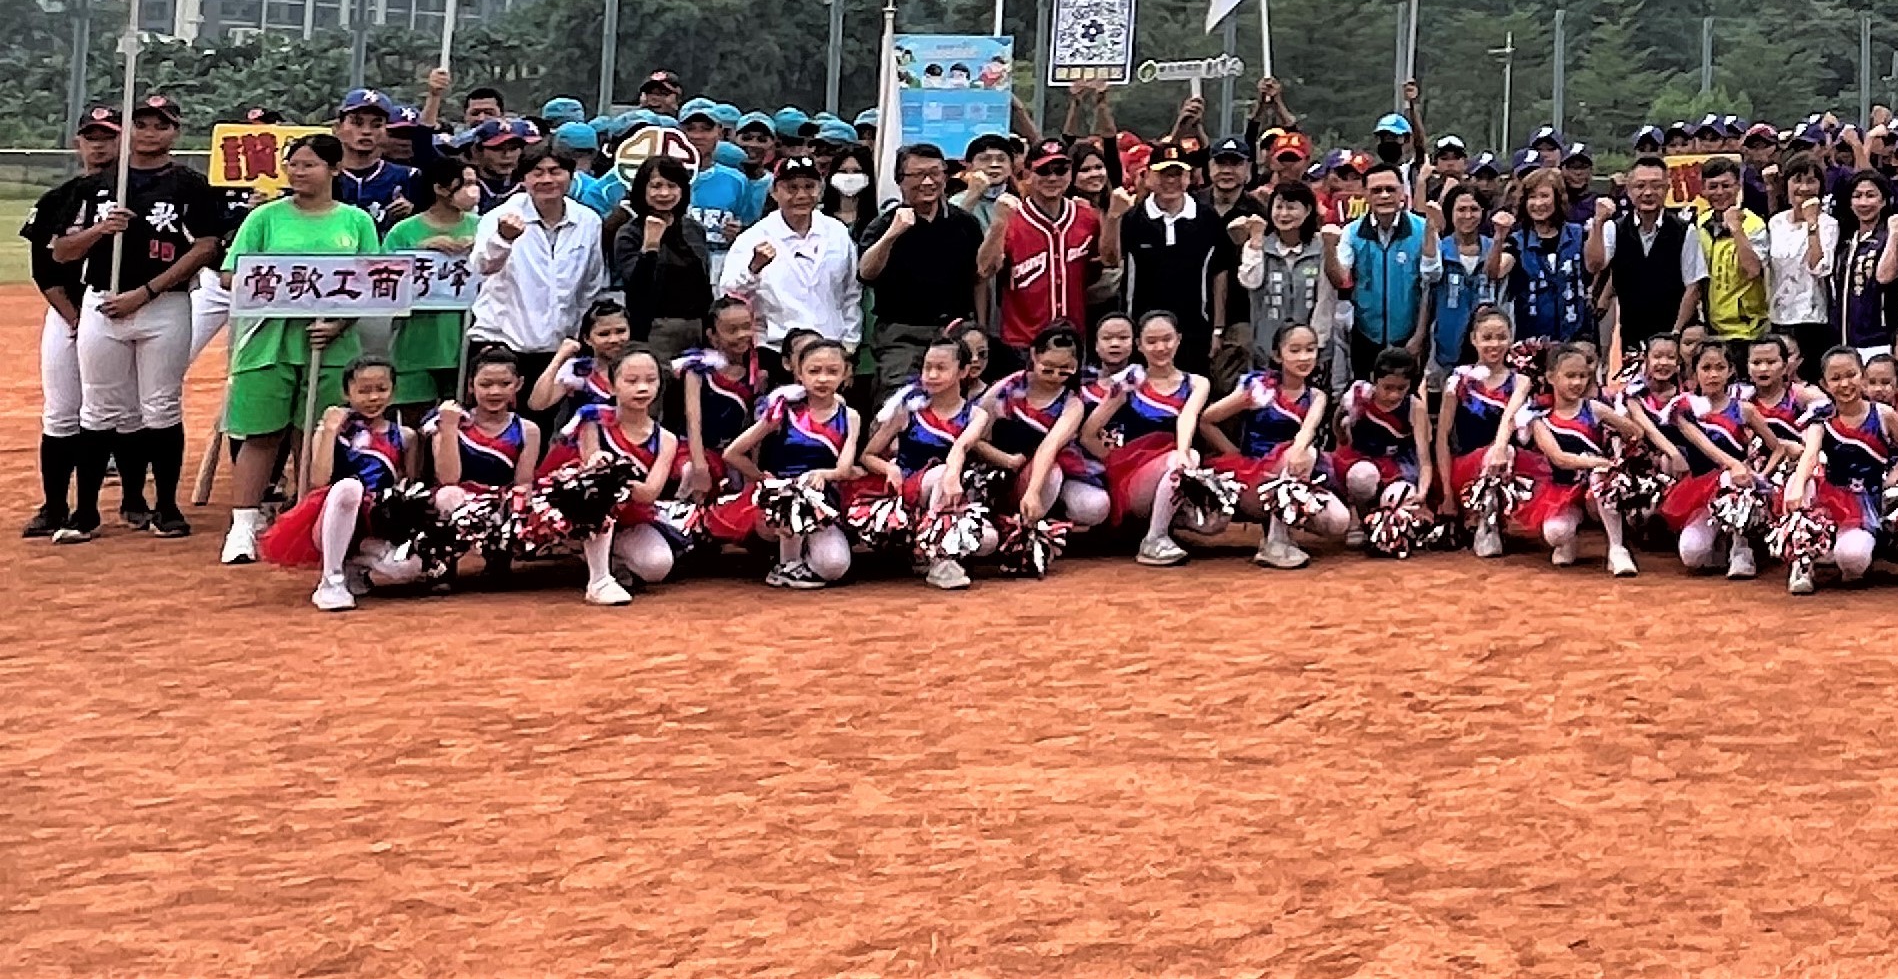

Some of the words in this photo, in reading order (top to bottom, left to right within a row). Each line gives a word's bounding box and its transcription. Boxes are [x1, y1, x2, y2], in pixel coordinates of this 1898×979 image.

[244, 264, 405, 304] 鶯歌工商
[413, 257, 481, 297] 秀峰
